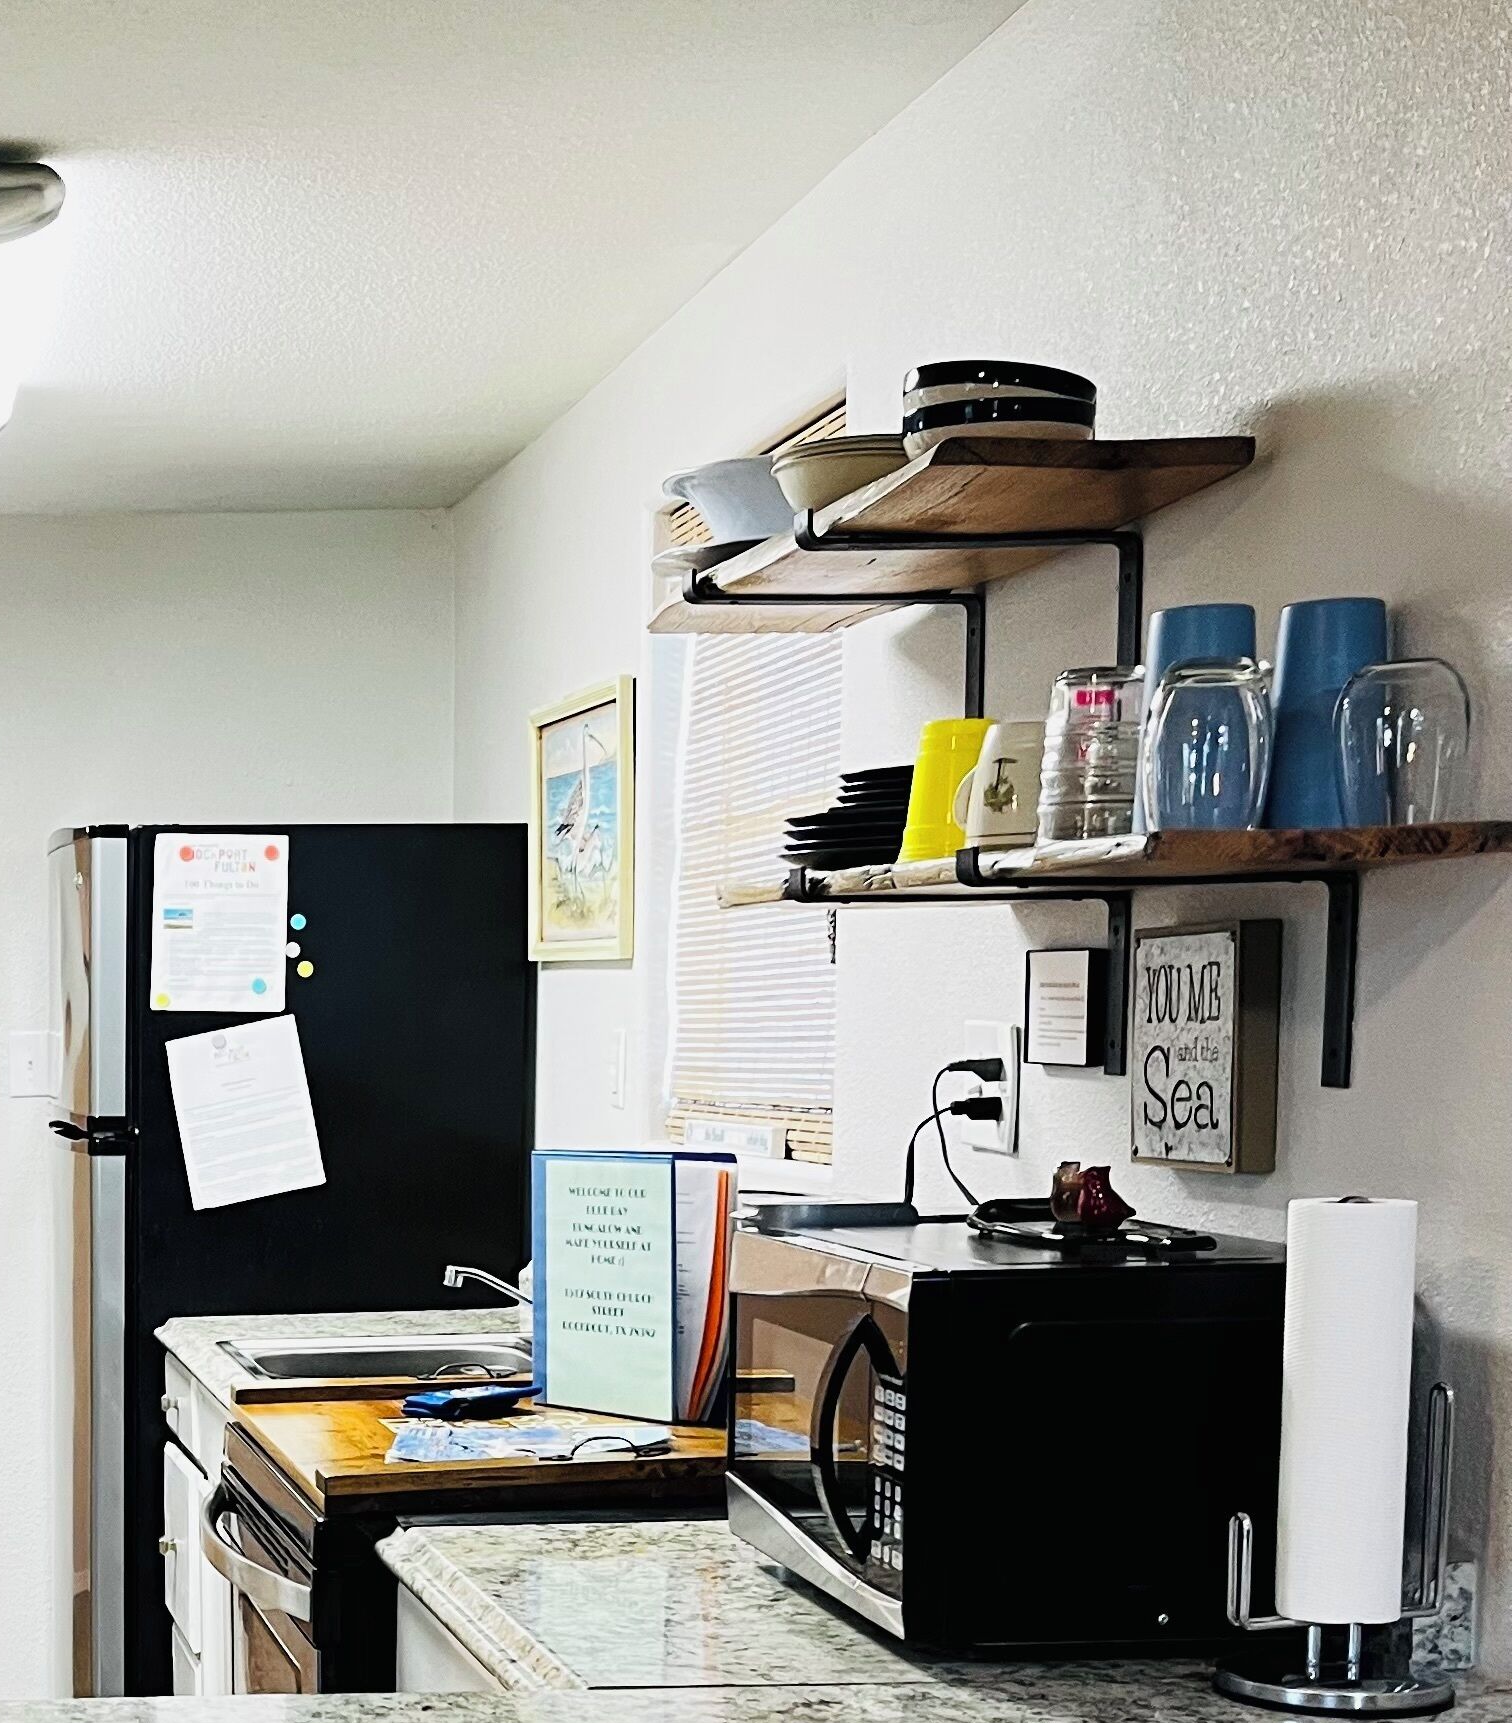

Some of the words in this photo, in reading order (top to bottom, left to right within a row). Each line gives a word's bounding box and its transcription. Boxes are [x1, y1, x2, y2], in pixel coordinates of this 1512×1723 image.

[1145, 964, 1181, 1024] YOU
[1186, 961, 1221, 1024] ME
[1178, 1037, 1199, 1061] and
[1200, 1036, 1219, 1061] the
[1143, 1045, 1219, 1130] Sea
[568, 1186, 611, 1198] WELCOME
[591, 1305, 625, 1317] STREET
